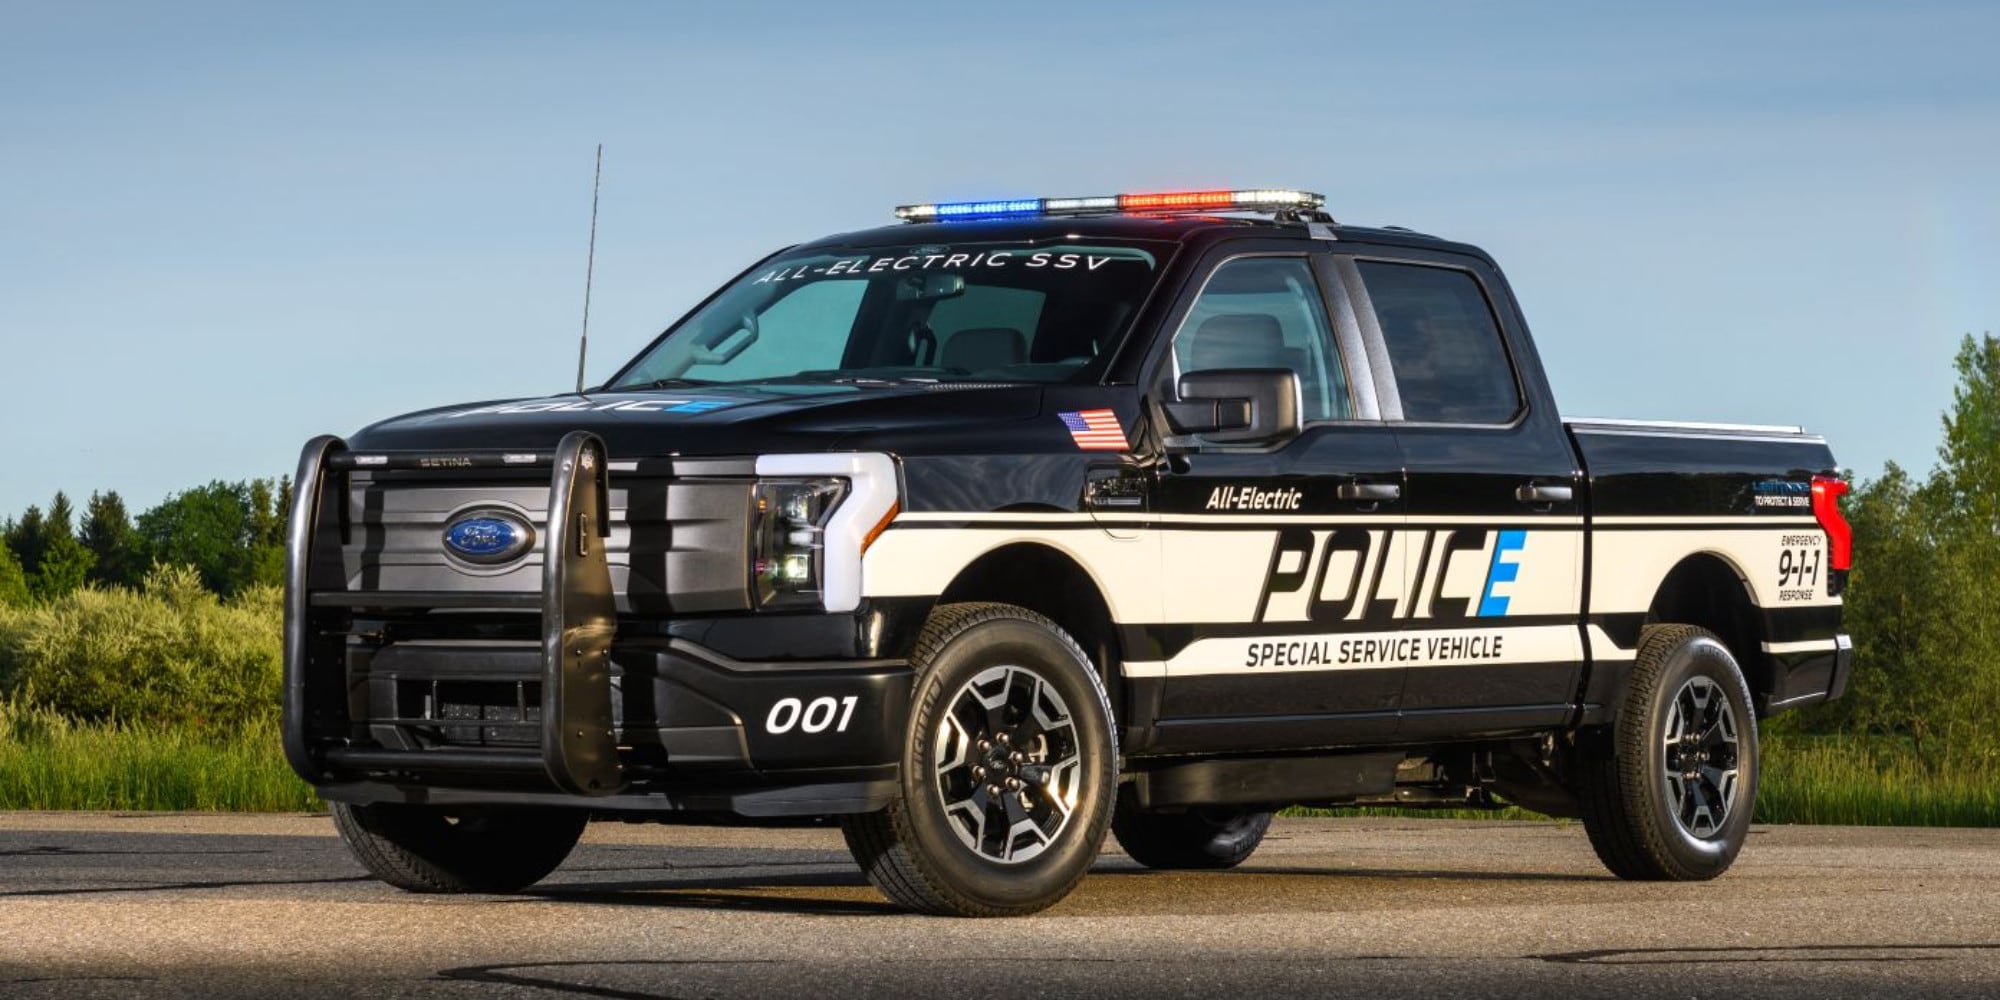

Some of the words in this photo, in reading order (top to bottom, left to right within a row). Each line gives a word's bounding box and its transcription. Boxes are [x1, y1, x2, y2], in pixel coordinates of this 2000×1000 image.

[753, 252, 1011, 286] ALL-ELECTRIC
[1025, 253, 1111, 271] SSV
[420, 456, 472, 468] SETINA
[1206, 486, 1303, 510] All-Electric
[1781, 535, 1821, 546] EMERGENCY
[1253, 529, 1529, 625] POLICE
[1778, 548, 1821, 587] 9-1-1
[1779, 590, 1813, 601] RESPONSE
[1245, 643, 1332, 668] SPECIAL
[1337, 637, 1421, 664] SERVICE
[1427, 635, 1504, 660] VEHICLE
[765, 695, 859, 734] 001
